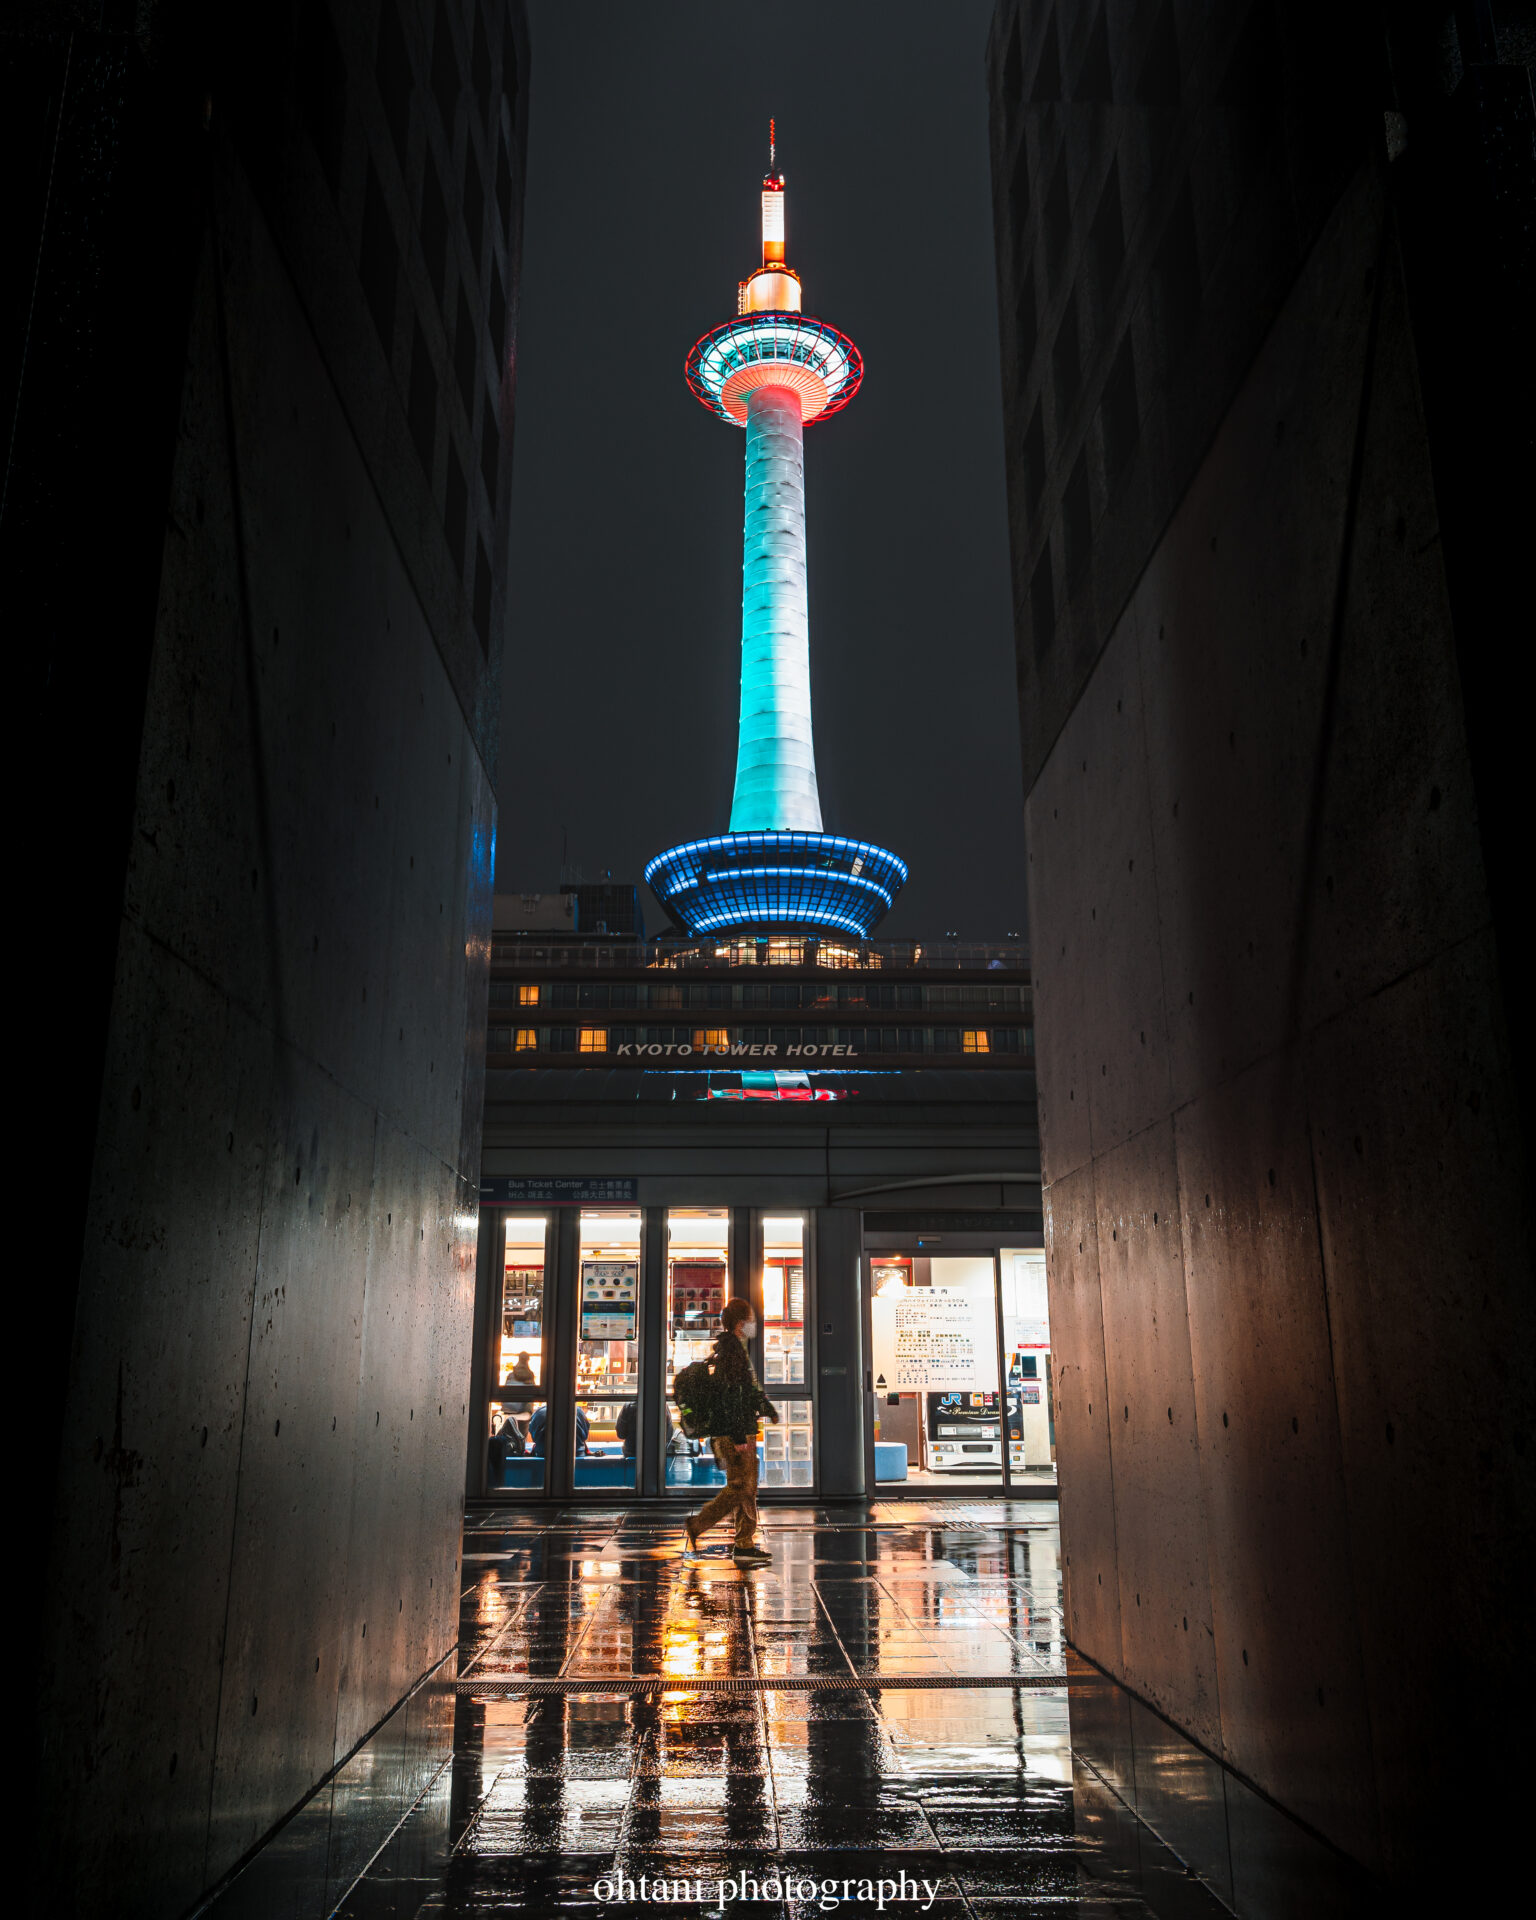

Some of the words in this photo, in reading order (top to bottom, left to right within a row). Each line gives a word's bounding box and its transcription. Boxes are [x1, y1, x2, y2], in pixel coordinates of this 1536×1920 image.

[616, 1043, 692, 1056] KYOTO
[701, 1043, 777, 1056] TOWER
[786, 1043, 858, 1056] HOTEL
[508, 1180, 525, 1189] Bus
[527, 1180, 553, 1189] Ticket
[555, 1180, 583, 1189] Center
[941, 1393, 962, 1406] JR
